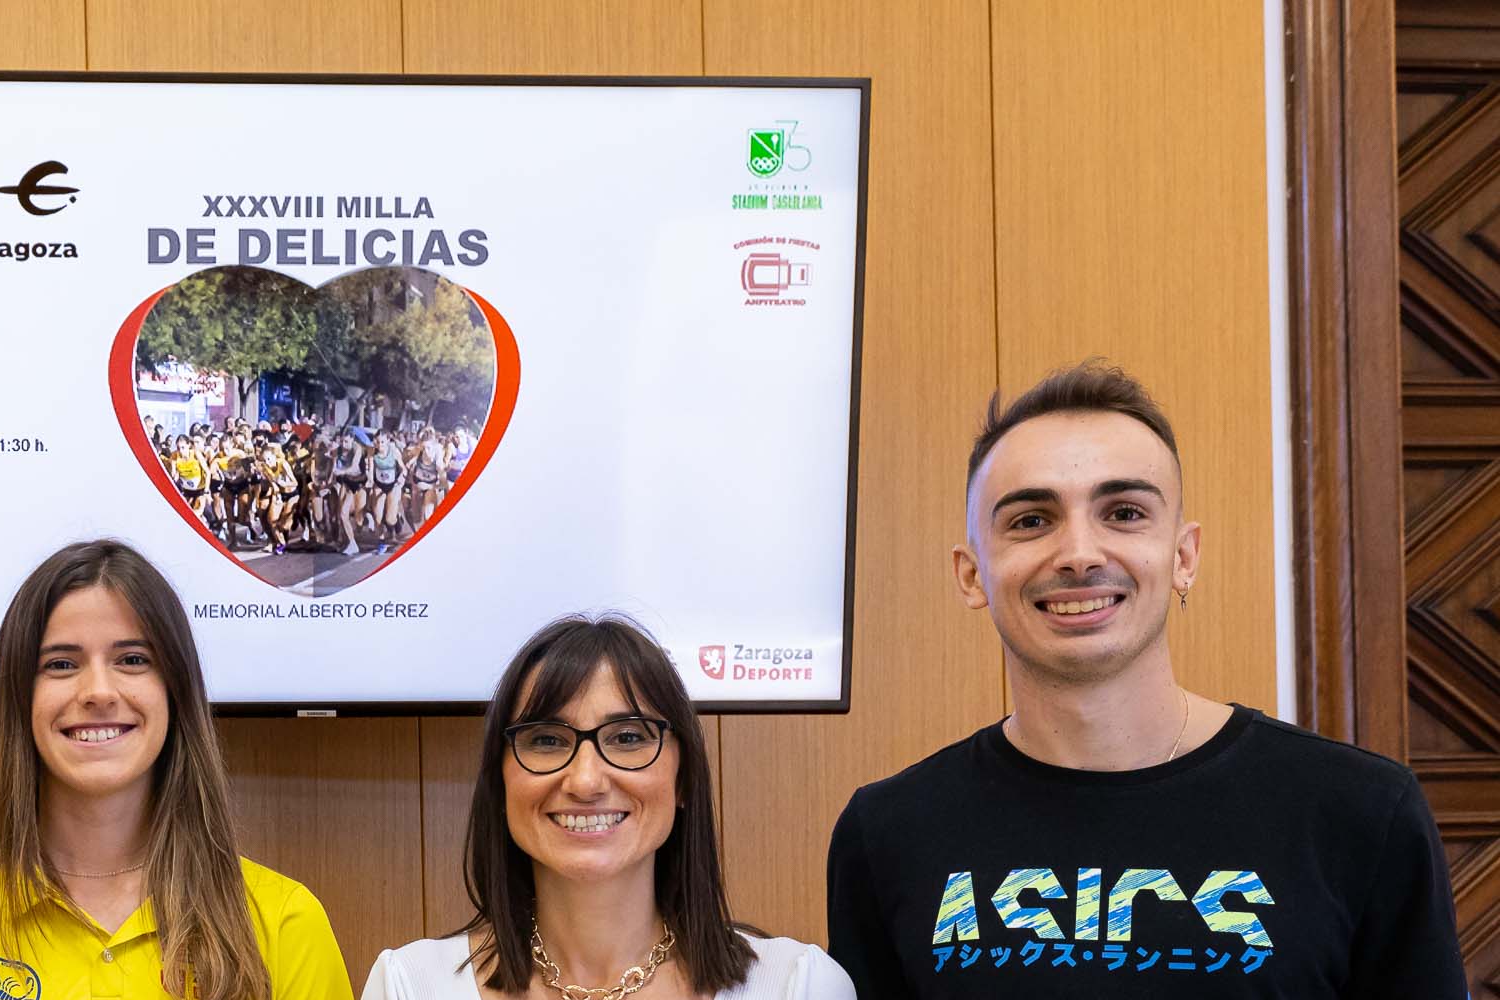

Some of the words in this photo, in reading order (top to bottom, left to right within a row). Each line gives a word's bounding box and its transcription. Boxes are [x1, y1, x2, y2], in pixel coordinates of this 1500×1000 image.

[202, 195, 324, 219] XXXVIII
[337, 196, 435, 219] MILLA
[732, 194, 769, 209] STADIUM
[147, 228, 217, 265] DE
[238, 228, 489, 267] DELICIAS
[35, 438, 49, 452] h.
[194, 603, 285, 618] MEMORIAL
[288, 603, 367, 618] ALBERTO
[372, 600, 429, 618] PÉREZ
[734, 645, 813, 664] Zaragoza
[733, 664, 813, 680] DEPORTE
[932, 868, 1276, 948] ASICS
[931, 940, 1274, 974] アシックス・ランニング
